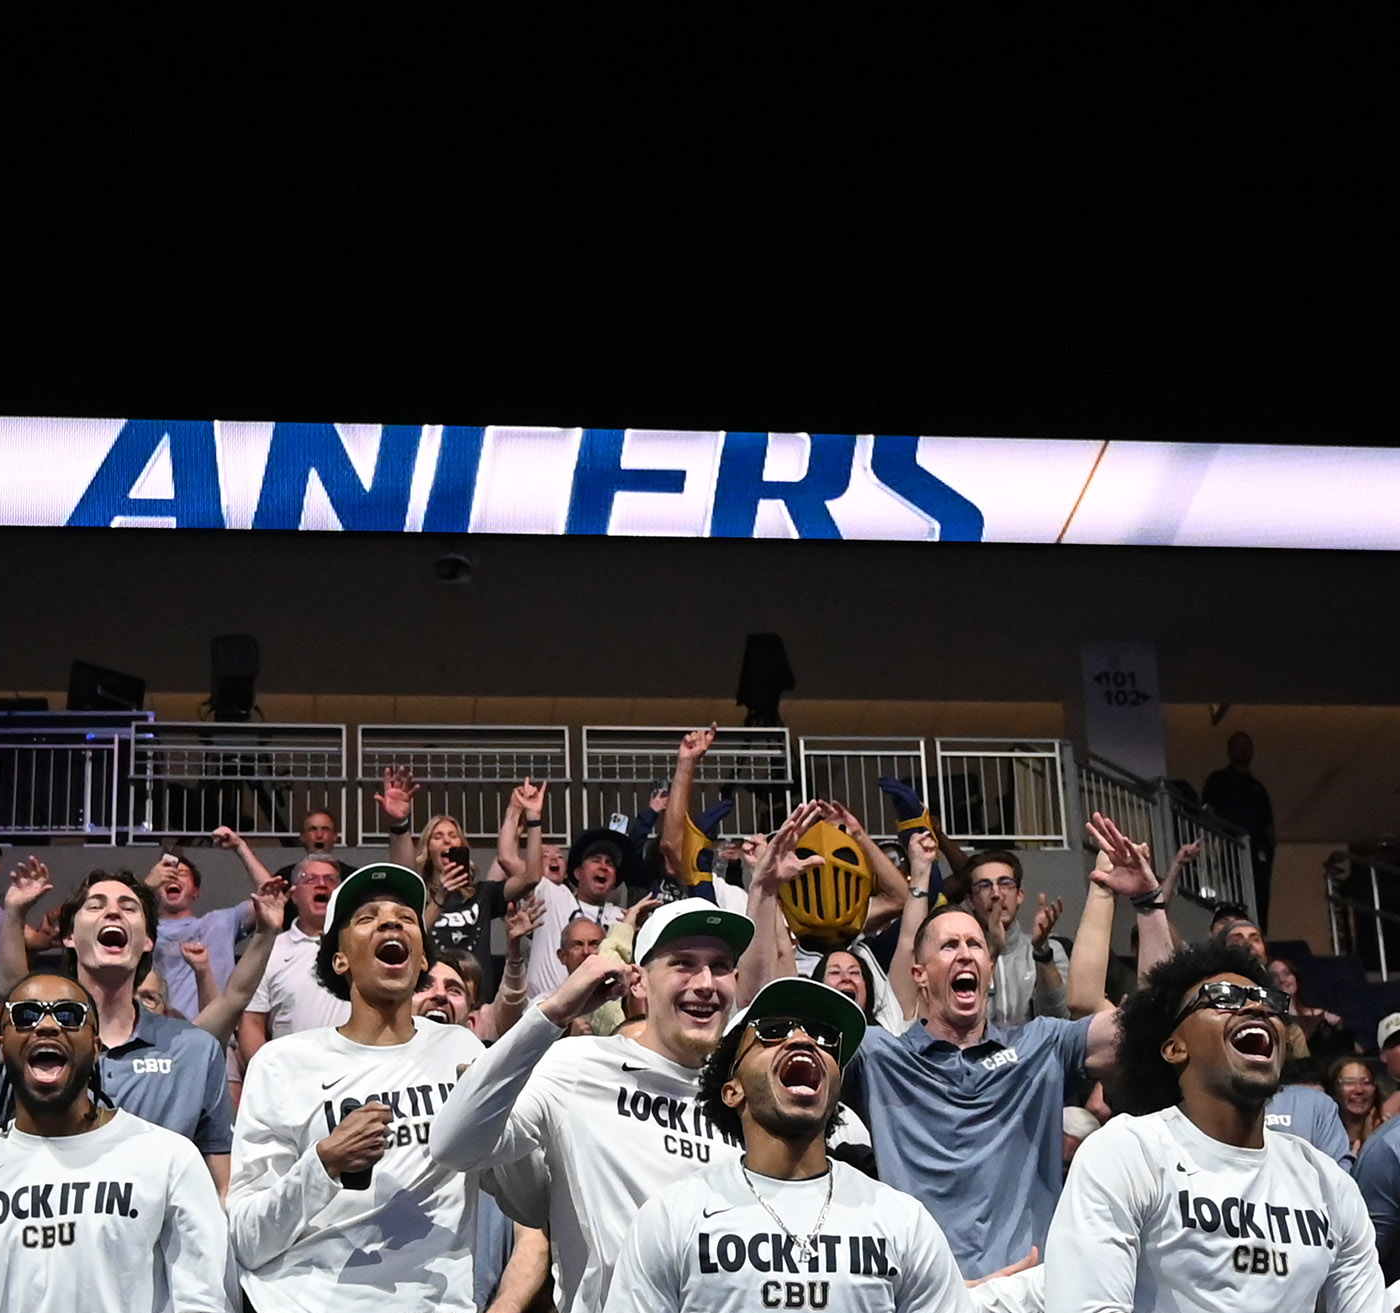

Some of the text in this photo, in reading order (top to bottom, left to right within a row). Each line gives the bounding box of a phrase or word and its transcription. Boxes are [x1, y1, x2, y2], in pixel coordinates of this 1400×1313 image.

[1104, 671, 1136, 688] 101
[1104, 690, 1141, 706] 102
[132, 1058, 173, 1074] CBU
[981, 1048, 1018, 1071] CBU
[407, 1085, 435, 1117] IT
[616, 1086, 689, 1134] LOCK
[1265, 1114, 1292, 1127] BU
[388, 1122, 431, 1149] BU
[664, 1134, 710, 1163] CBU
[60, 1181, 91, 1220] IT
[99, 1181, 139, 1219] IN.
[1178, 1190, 1335, 1250] LOCK IT IN.
[21, 1221, 77, 1249] CBU
[698, 1232, 899, 1277] LOCK IT IN.
[1232, 1244, 1290, 1277] CBU
[761, 1279, 830, 1310] CBU
